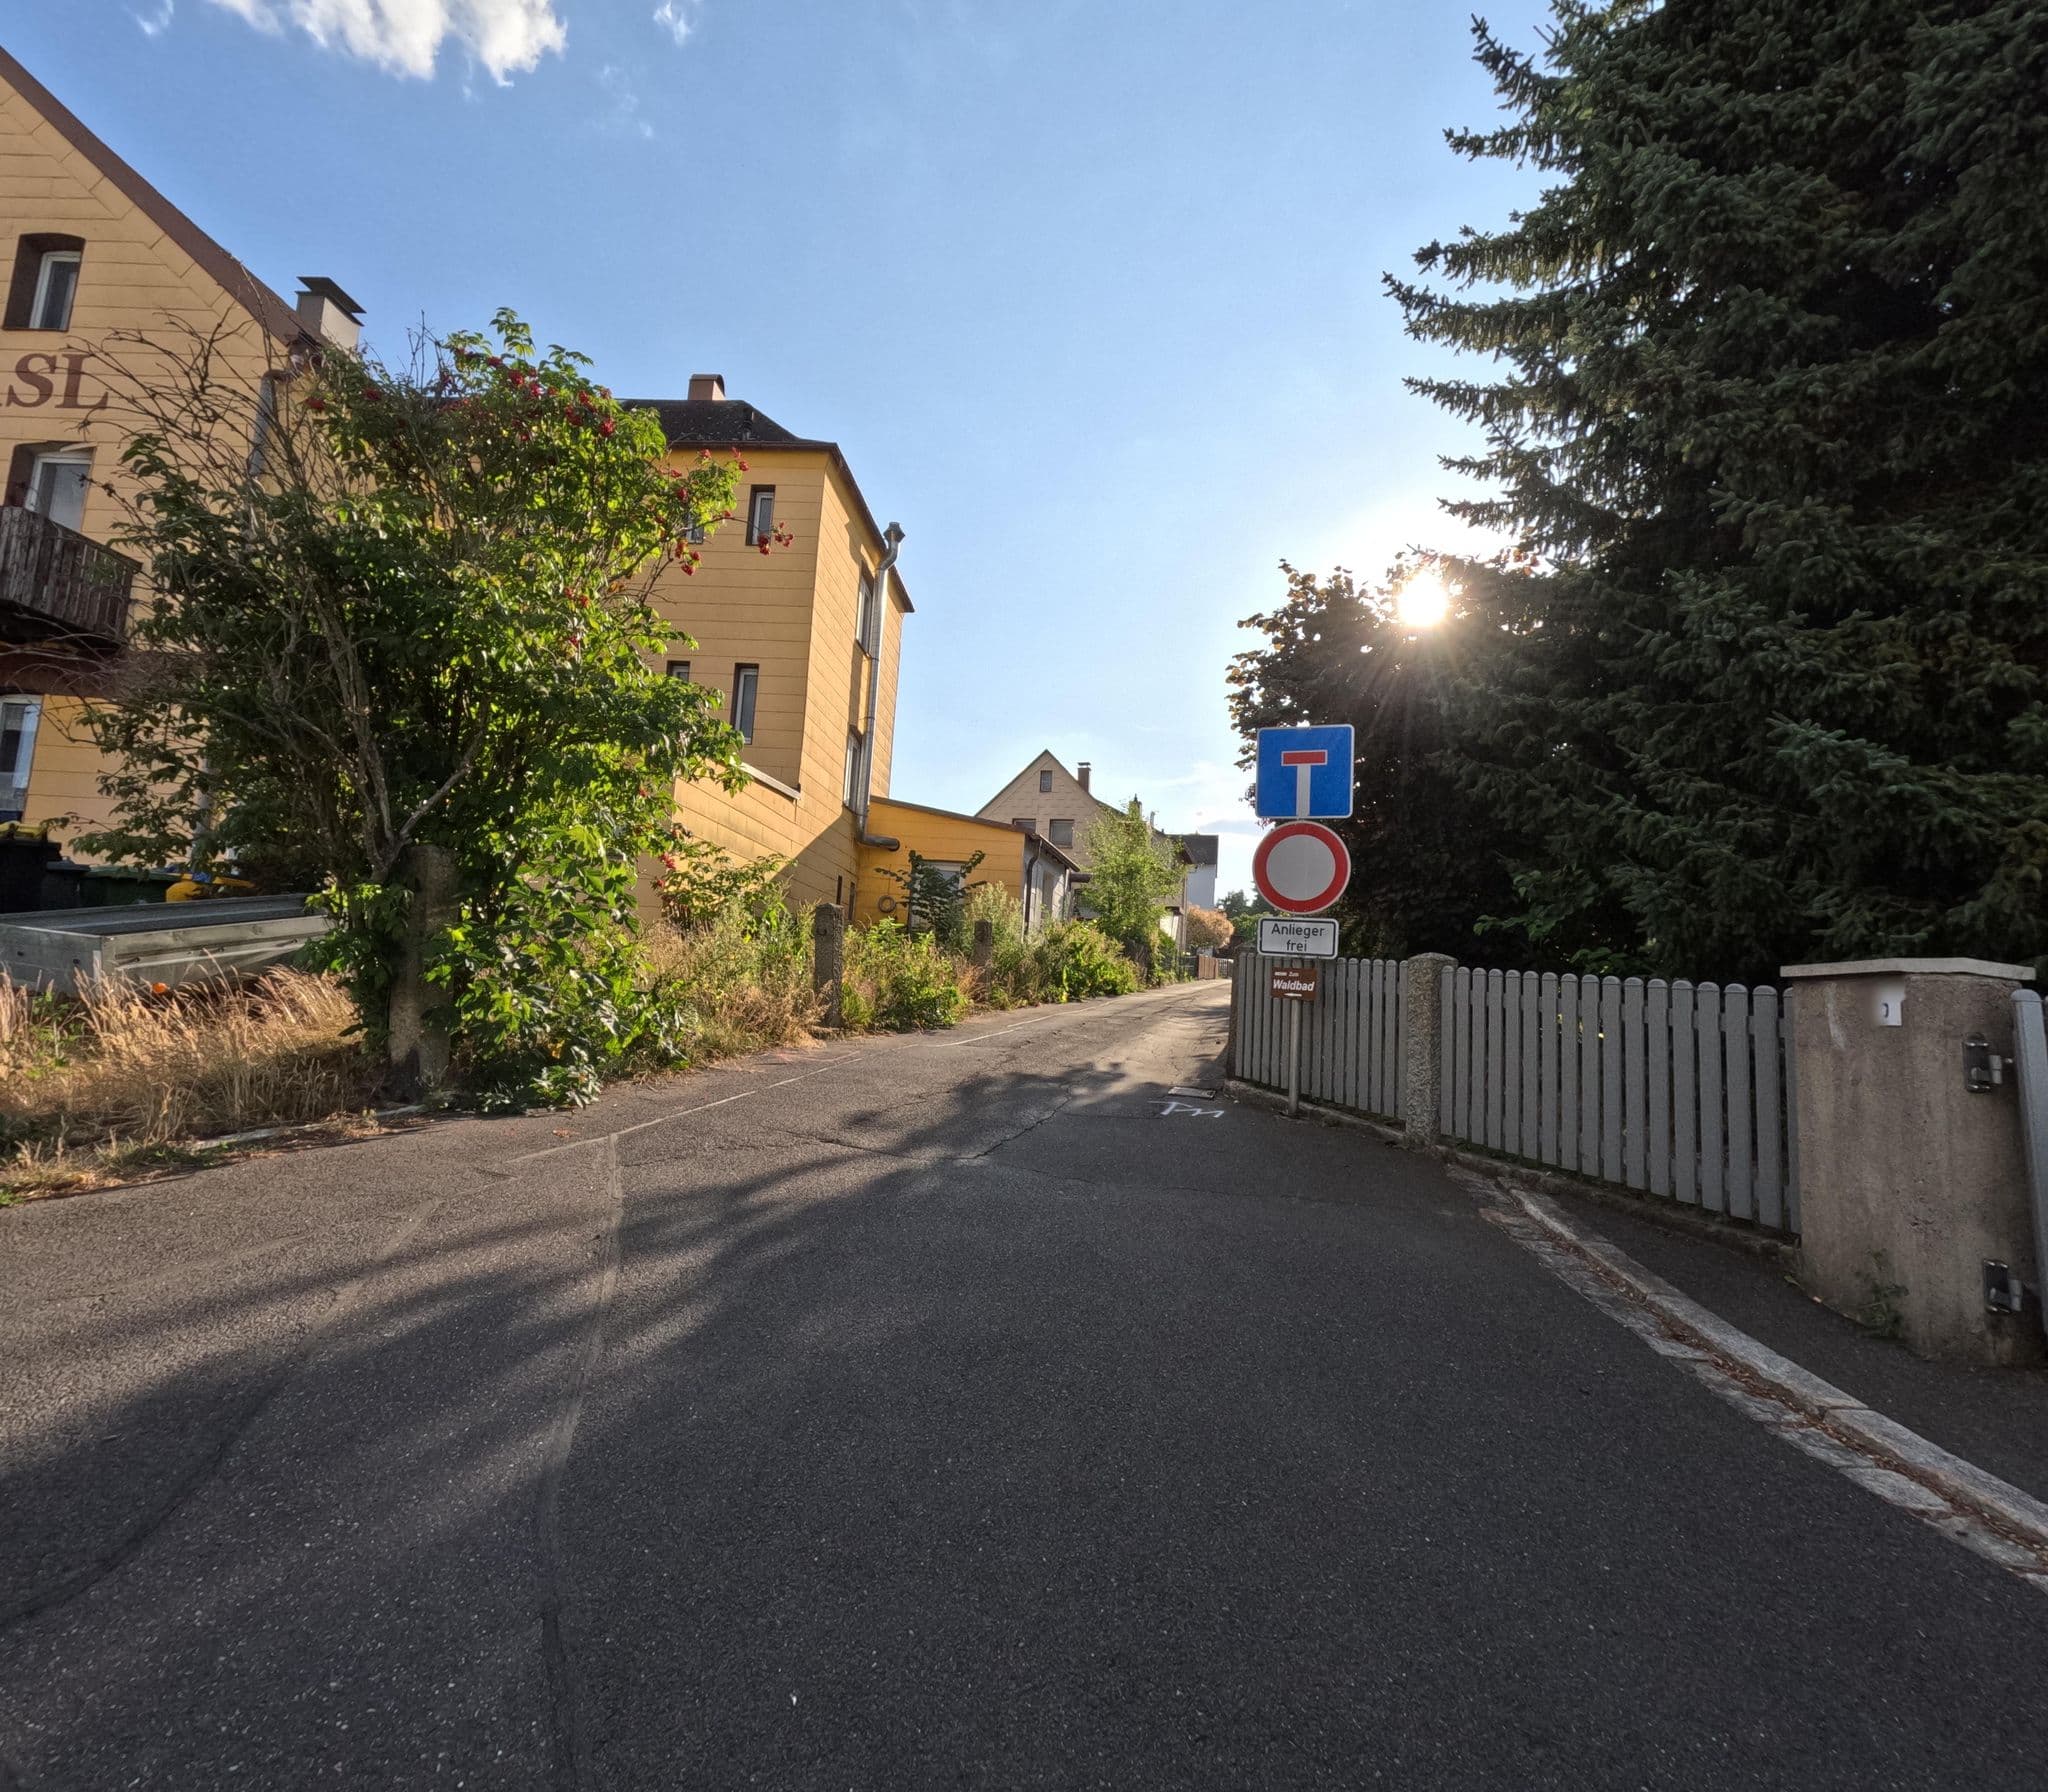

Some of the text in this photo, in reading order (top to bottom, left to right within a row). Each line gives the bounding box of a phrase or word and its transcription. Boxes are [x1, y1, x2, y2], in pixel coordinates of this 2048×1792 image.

[0, 353, 108, 410] SL
[1271, 923, 1325, 939] Anlieger
[1286, 939, 1307, 952] frei
[1273, 979, 1315, 991] Waldbad
